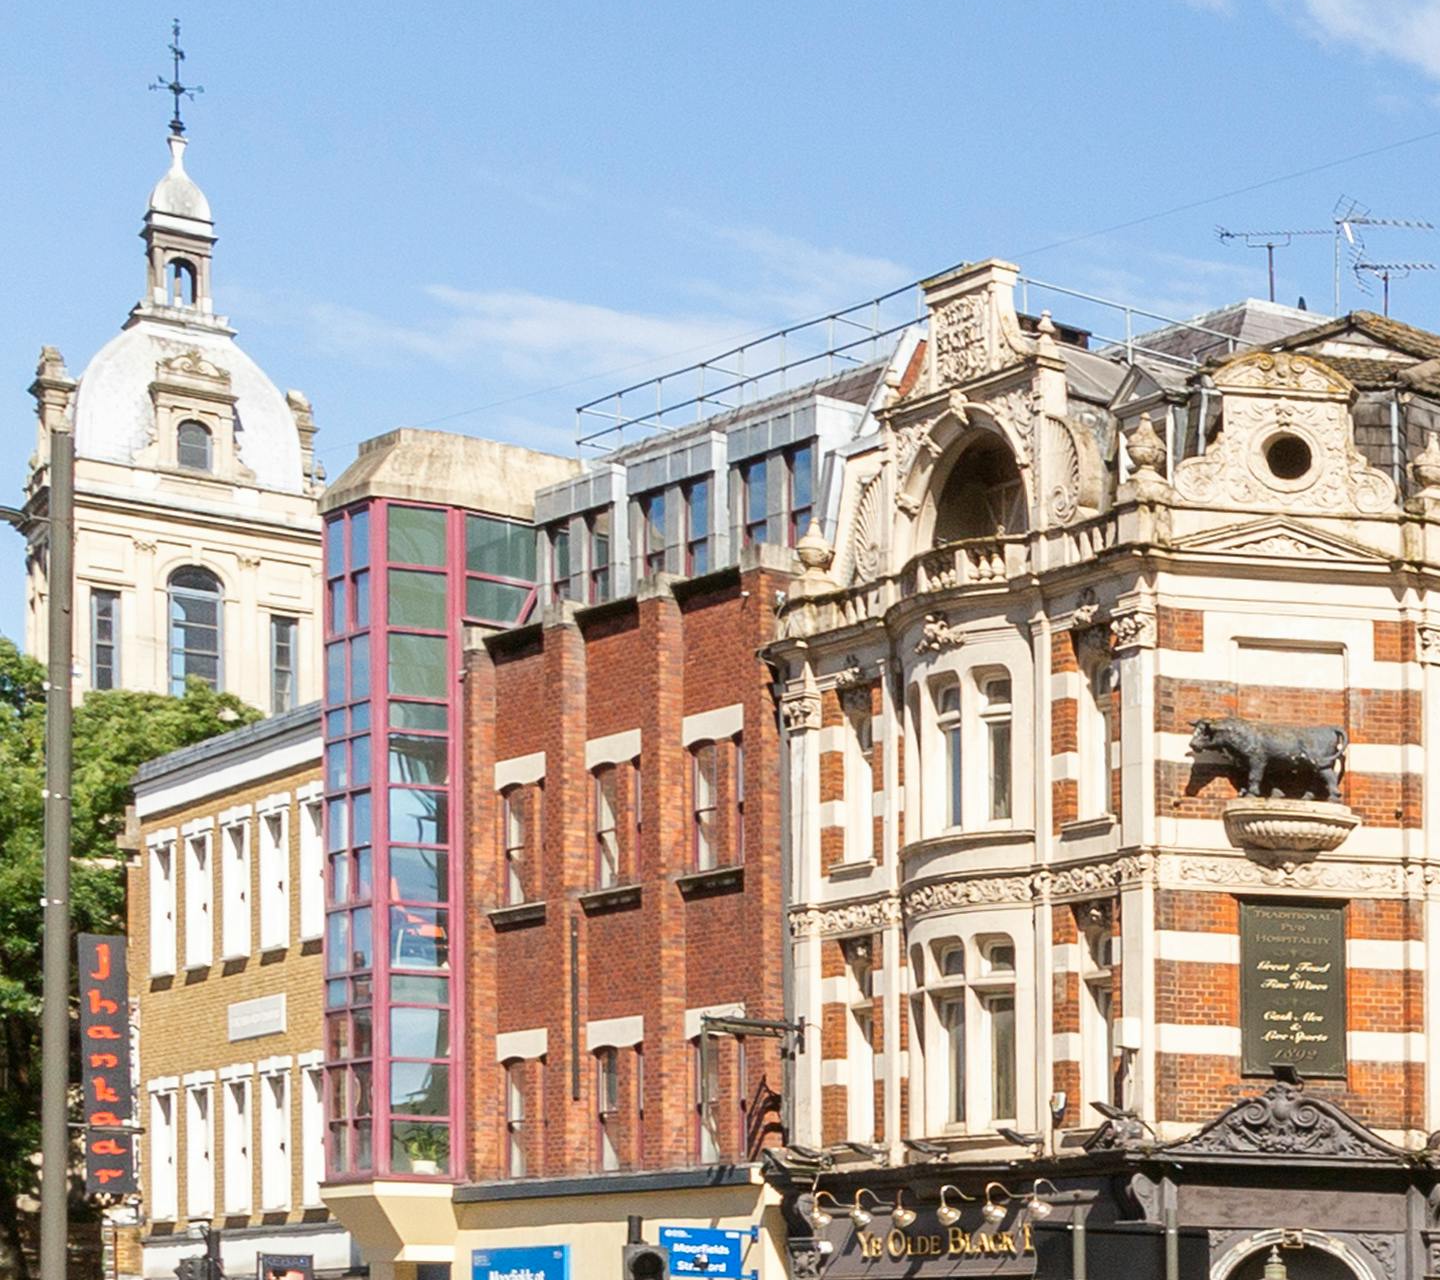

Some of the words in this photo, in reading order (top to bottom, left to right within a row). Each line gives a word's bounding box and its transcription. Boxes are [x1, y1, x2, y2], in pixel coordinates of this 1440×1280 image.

[1254, 909, 1333, 921] TRADITIONAL
[1255, 934, 1331, 945] HOSPITALITY
[1256, 960, 1291, 972] Great
[1295, 961, 1331, 973] Food
[1260, 978, 1291, 990] Fine
[1292, 979, 1329, 991] Wines
[1274, 1047, 1318, 1060] 1892
